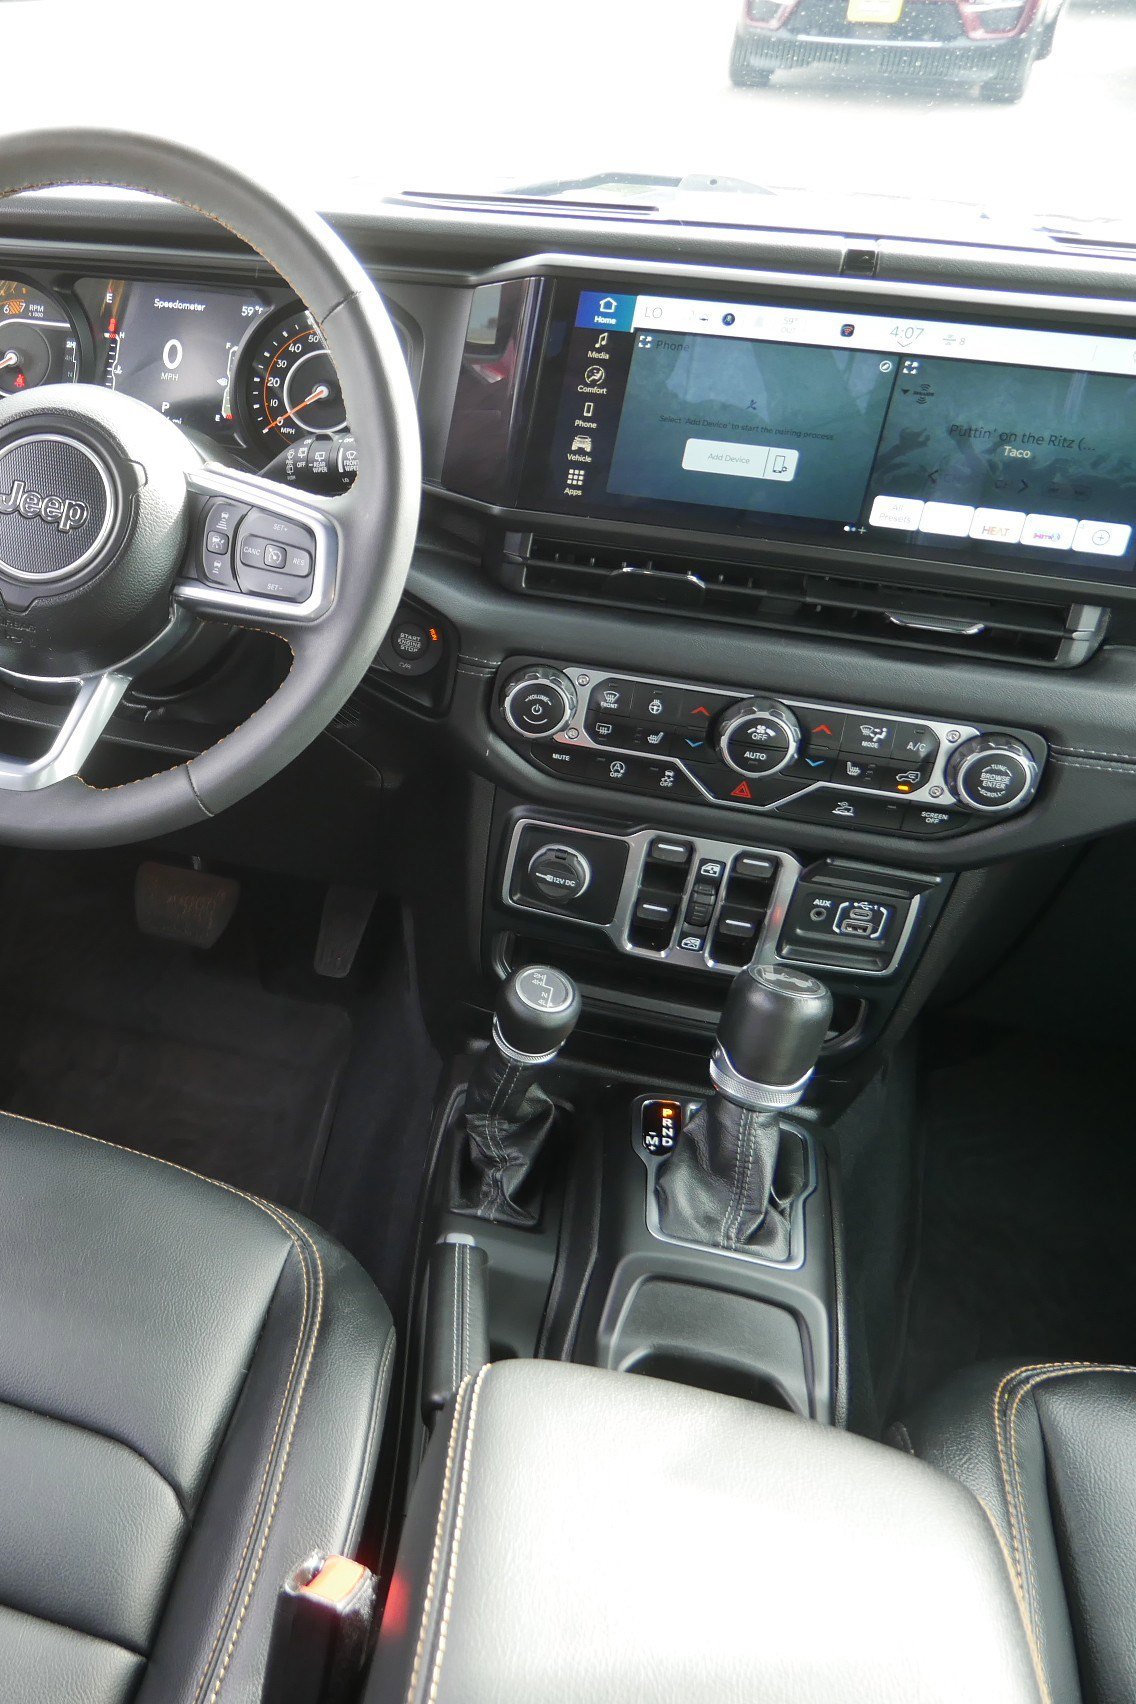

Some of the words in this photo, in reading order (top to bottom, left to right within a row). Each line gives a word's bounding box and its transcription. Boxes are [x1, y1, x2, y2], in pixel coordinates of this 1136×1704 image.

[3, 304, 10, 314] 6
[20, 303, 26, 312] 7
[29, 304, 44, 312] RPM
[154, 298, 206, 312] Speedometer
[644, 307, 663, 319] LO
[594, 316, 617, 325] Home
[890, 326, 924, 340] 4:07
[308, 335, 320, 343] 50
[288, 343, 302, 353] 40
[656, 340, 690, 352] Phone
[162, 338, 183, 370] 0
[587, 351, 609, 359] Media
[276, 360, 287, 368] 30
[160, 372, 179, 382] MPH
[267, 377, 280, 387] 20
[577, 385, 607, 394] Comfort
[161, 401, 170, 413] P
[270, 399, 278, 407] 10
[215, 414, 221, 422] E
[574, 420, 597, 429] Phone
[659, 415, 682, 424] Select
[740, 424, 759, 432] start
[774, 429, 802, 439] pairing
[280, 427, 295, 435] MPH
[950, 424, 997, 439] Puttin'
[999, 431, 1017, 441] on
[1021, 432, 1044, 446] the
[1048, 434, 1075, 448] Ritz
[1003, 446, 1031, 458] Taco
[567, 453, 592, 463] Vehicle
[707, 453, 723, 462] Add
[724, 454, 751, 464] Device
[564, 487, 582, 497] Apps
[879, 512, 911, 524] Presets
[981, 525, 1010, 537] HEAT
[243, 546, 261, 556] CANC
[292, 557, 305, 566] RES
[400, 632, 421, 642] START
[397, 638, 421, 648] ENGINE
[400, 644, 418, 652] STOP
[752, 733, 768, 741] OFF
[861, 741, 879, 749] MODE
[907, 742, 926, 752] A/C
[552, 753, 570, 761] MUTE
[744, 751, 767, 760] AUTO
[991, 764, 1008, 772] TUNE
[980, 772, 1011, 783] BROWSE
[982, 781, 1006, 789] ENTER
[979, 790, 1002, 798] SCROLL
[921, 811, 949, 820] SCREEN
[553, 877, 564, 885] 12V
[813, 899, 832, 907] AUX
[645, 1136, 659, 1145] M
